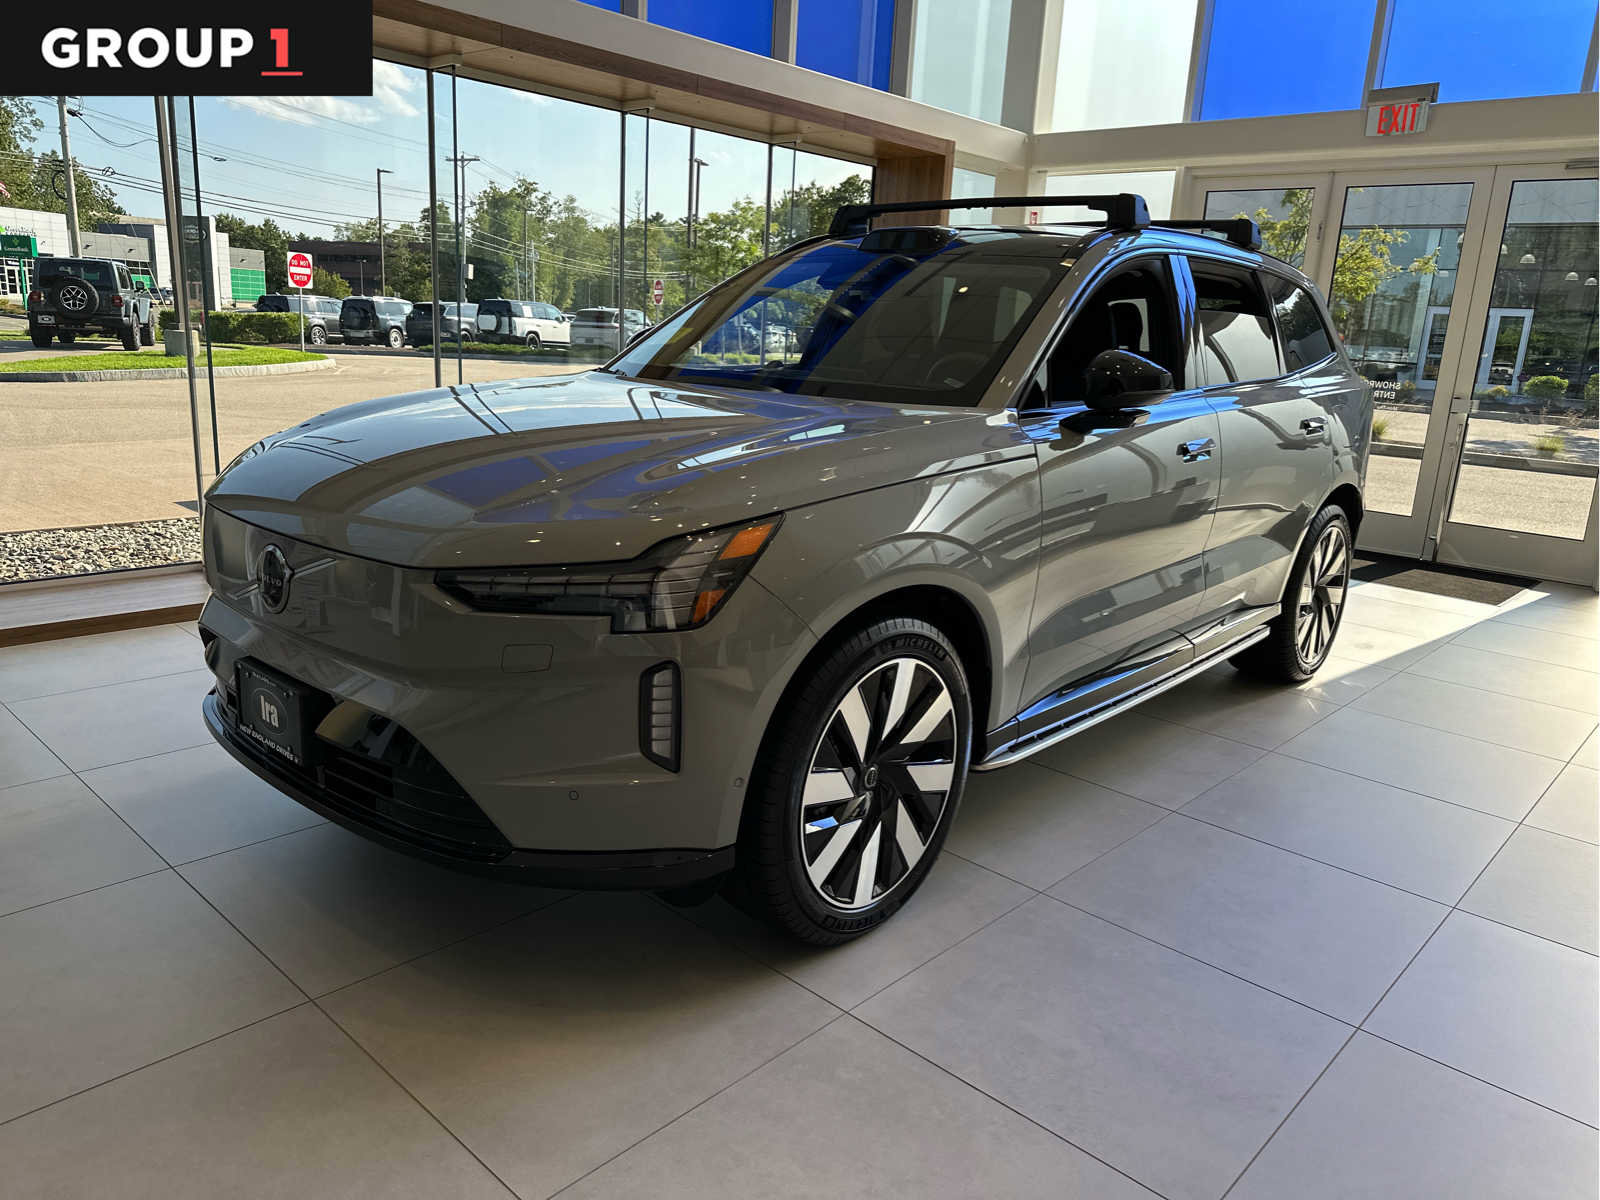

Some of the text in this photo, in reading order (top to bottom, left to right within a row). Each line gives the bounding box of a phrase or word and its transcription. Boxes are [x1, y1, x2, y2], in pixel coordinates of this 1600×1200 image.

[1377, 103, 1420, 134] EXIT
[260, 695, 279, 728] Ira
[239, 724, 251, 735] NEW
[251, 730, 276, 749] ENGLAND
[275, 744, 294, 761] DRIVES
